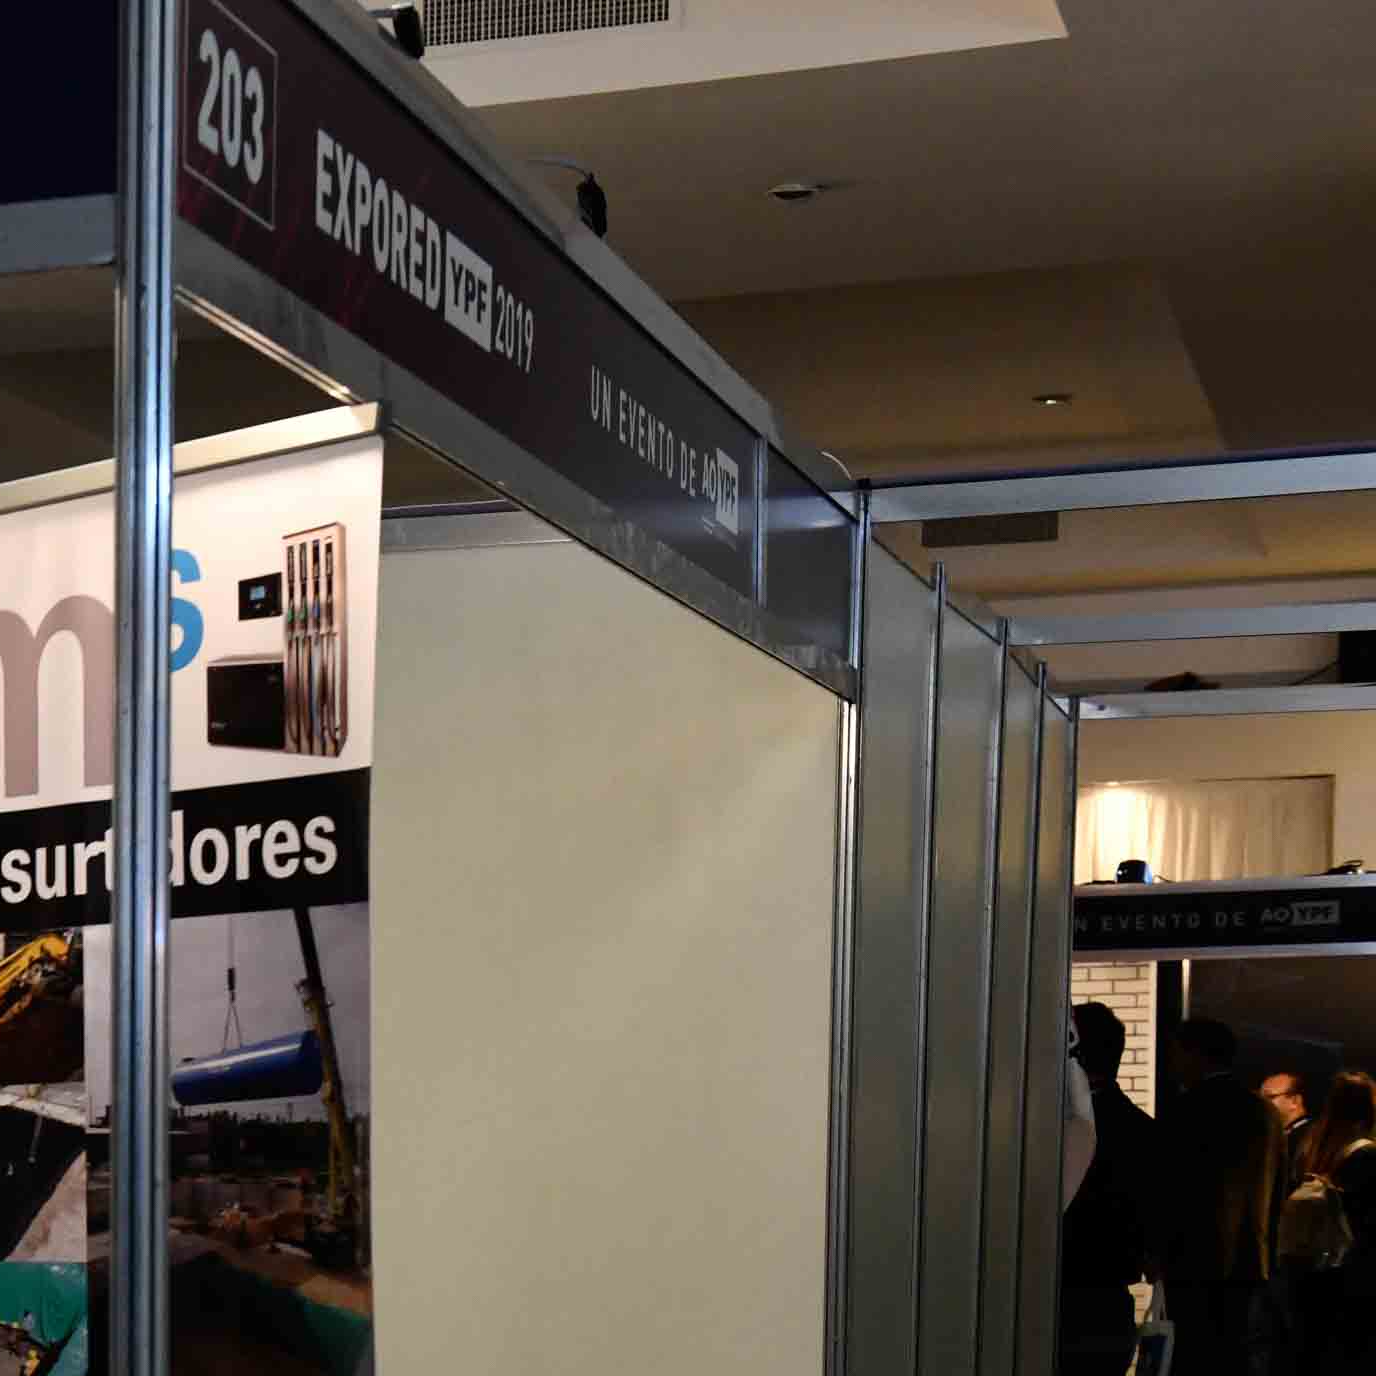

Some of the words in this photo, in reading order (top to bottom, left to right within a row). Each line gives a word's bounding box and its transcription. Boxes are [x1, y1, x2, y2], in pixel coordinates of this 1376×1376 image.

[198, 29, 264, 184] 203
[316, 128, 446, 311] EXPORED
[450, 254, 487, 327] YPF
[495, 285, 535, 373] 2019
[590, 364, 612, 432] UN
[619, 388, 675, 480] EVENTO
[680, 440, 696, 497] DE
[1101, 911, 1200, 931] EVENTO
[1215, 911, 1246, 928] DE
